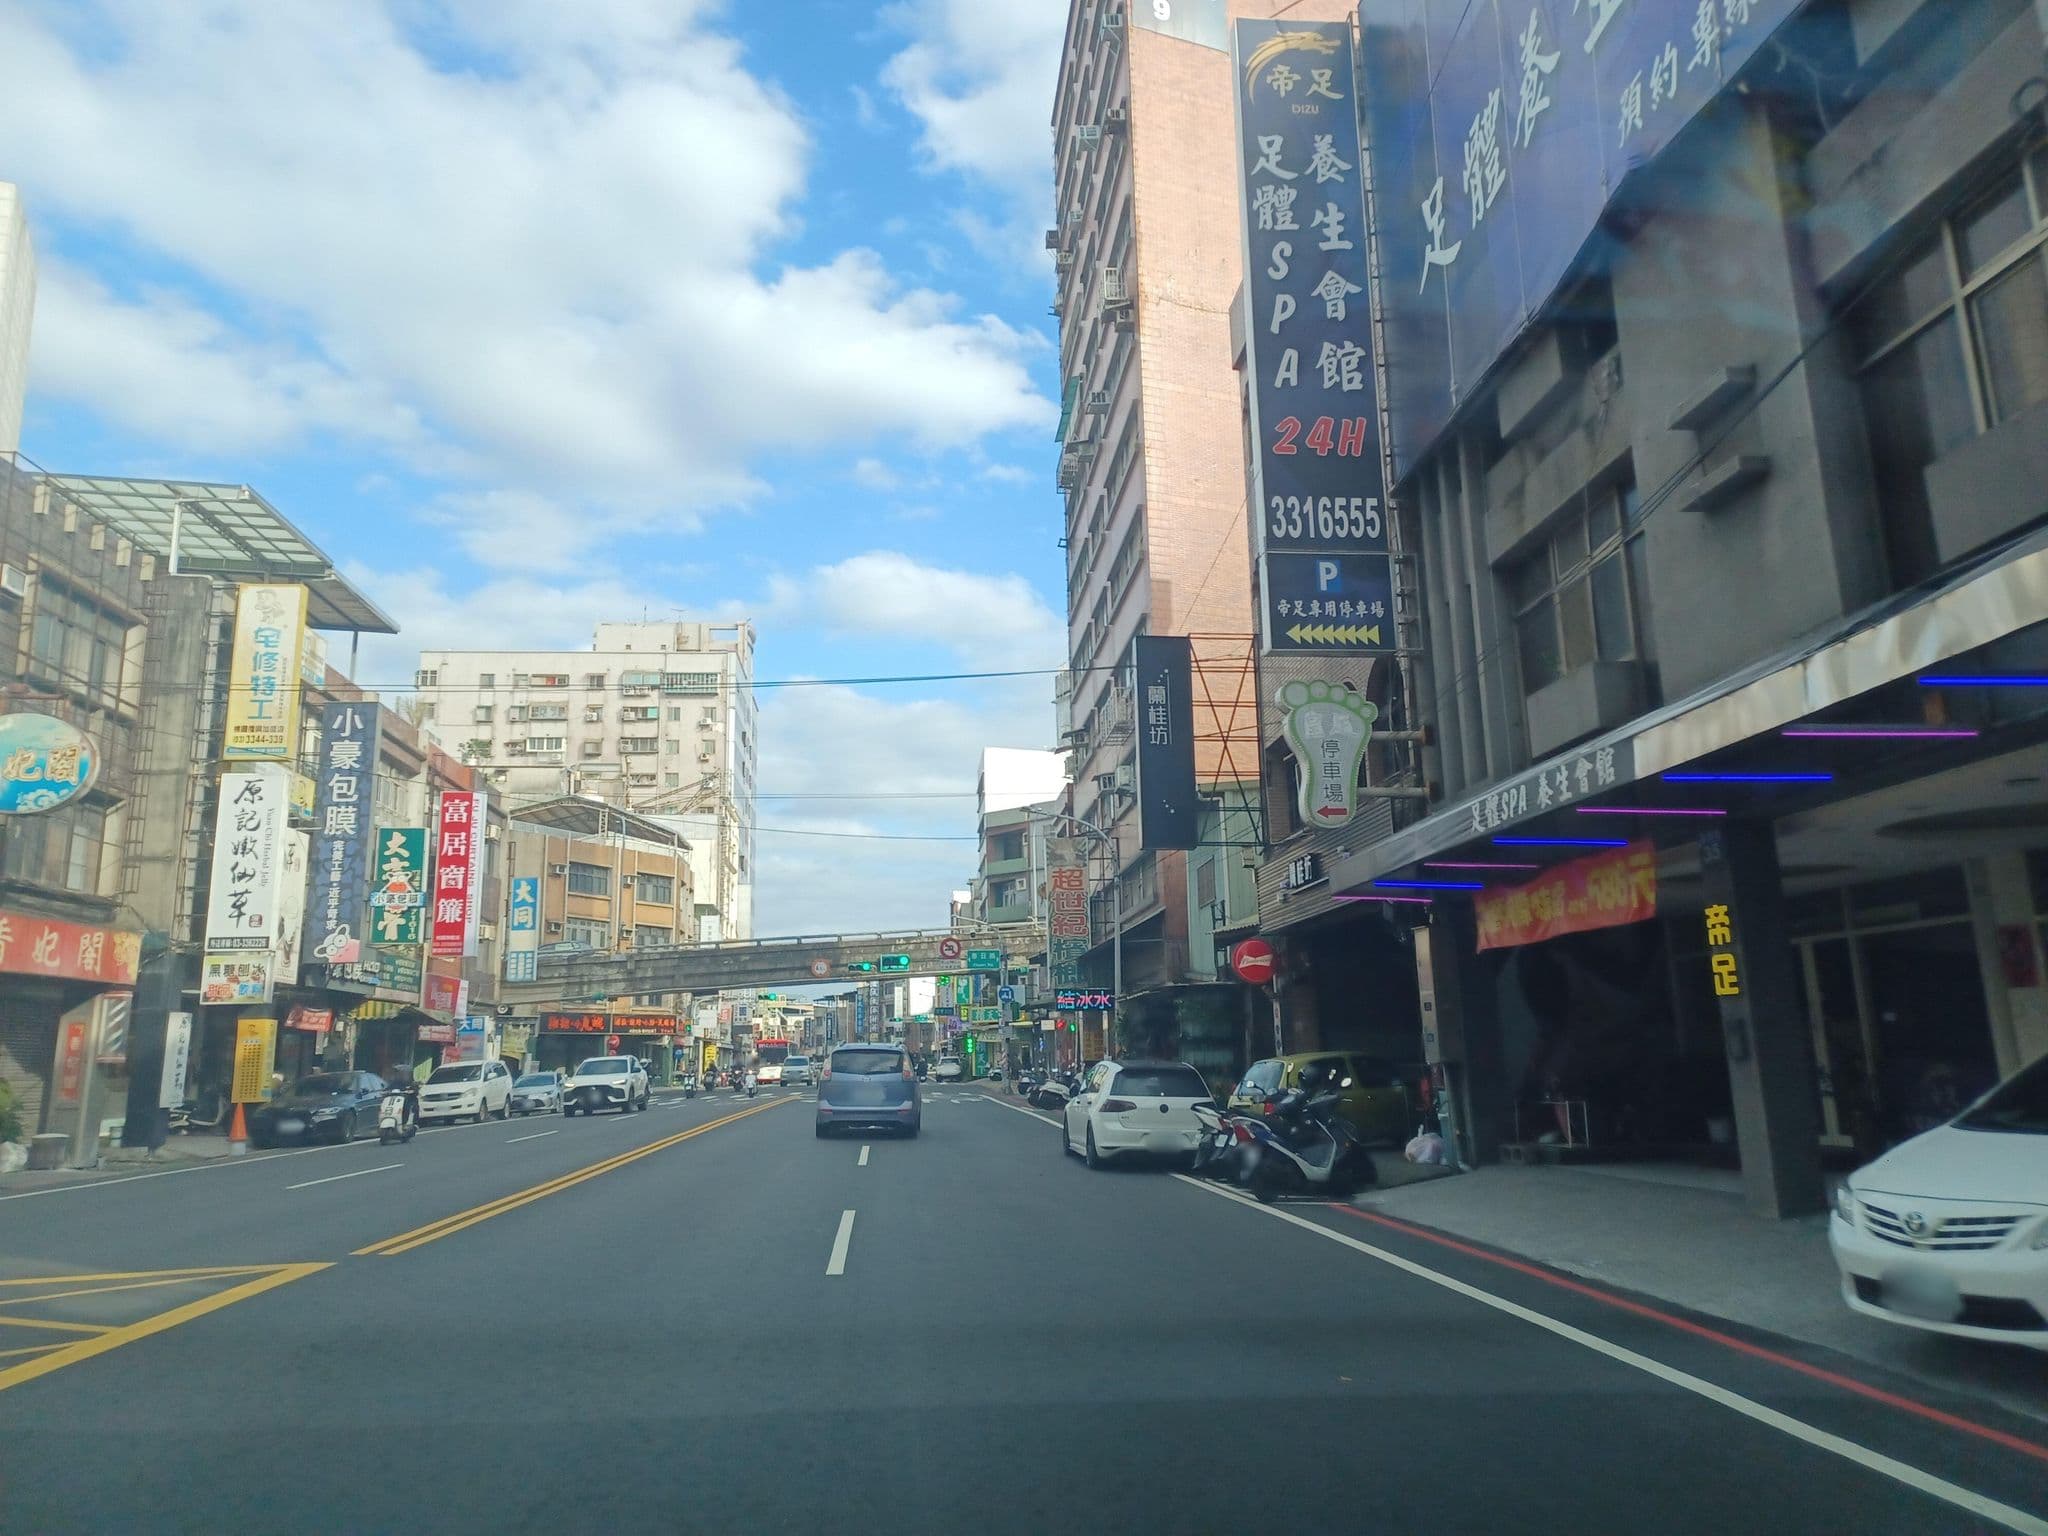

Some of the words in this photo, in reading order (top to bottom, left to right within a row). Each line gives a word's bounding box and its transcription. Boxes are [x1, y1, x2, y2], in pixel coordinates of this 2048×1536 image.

[1266, 64, 1345, 100] 帝足
[1304, 134, 1366, 392] 養生會館
[1273, 416, 1367, 457] 24H
[1271, 495, 1381, 539] 3316555
[1318, 561, 1339, 592] P
[1277, 599, 1385, 619] 帝足專用停車場
[247, 626, 281, 720] 宅修特工
[323, 707, 363, 836] 小豪包膜
[1321, 739, 1344, 803] 停車場
[1537, 747, 1616, 809] 養生會館
[435, 798, 471, 924] 富居窗簾
[514, 879, 537, 929] 大同
[1703, 904, 1740, 996] 帝足
